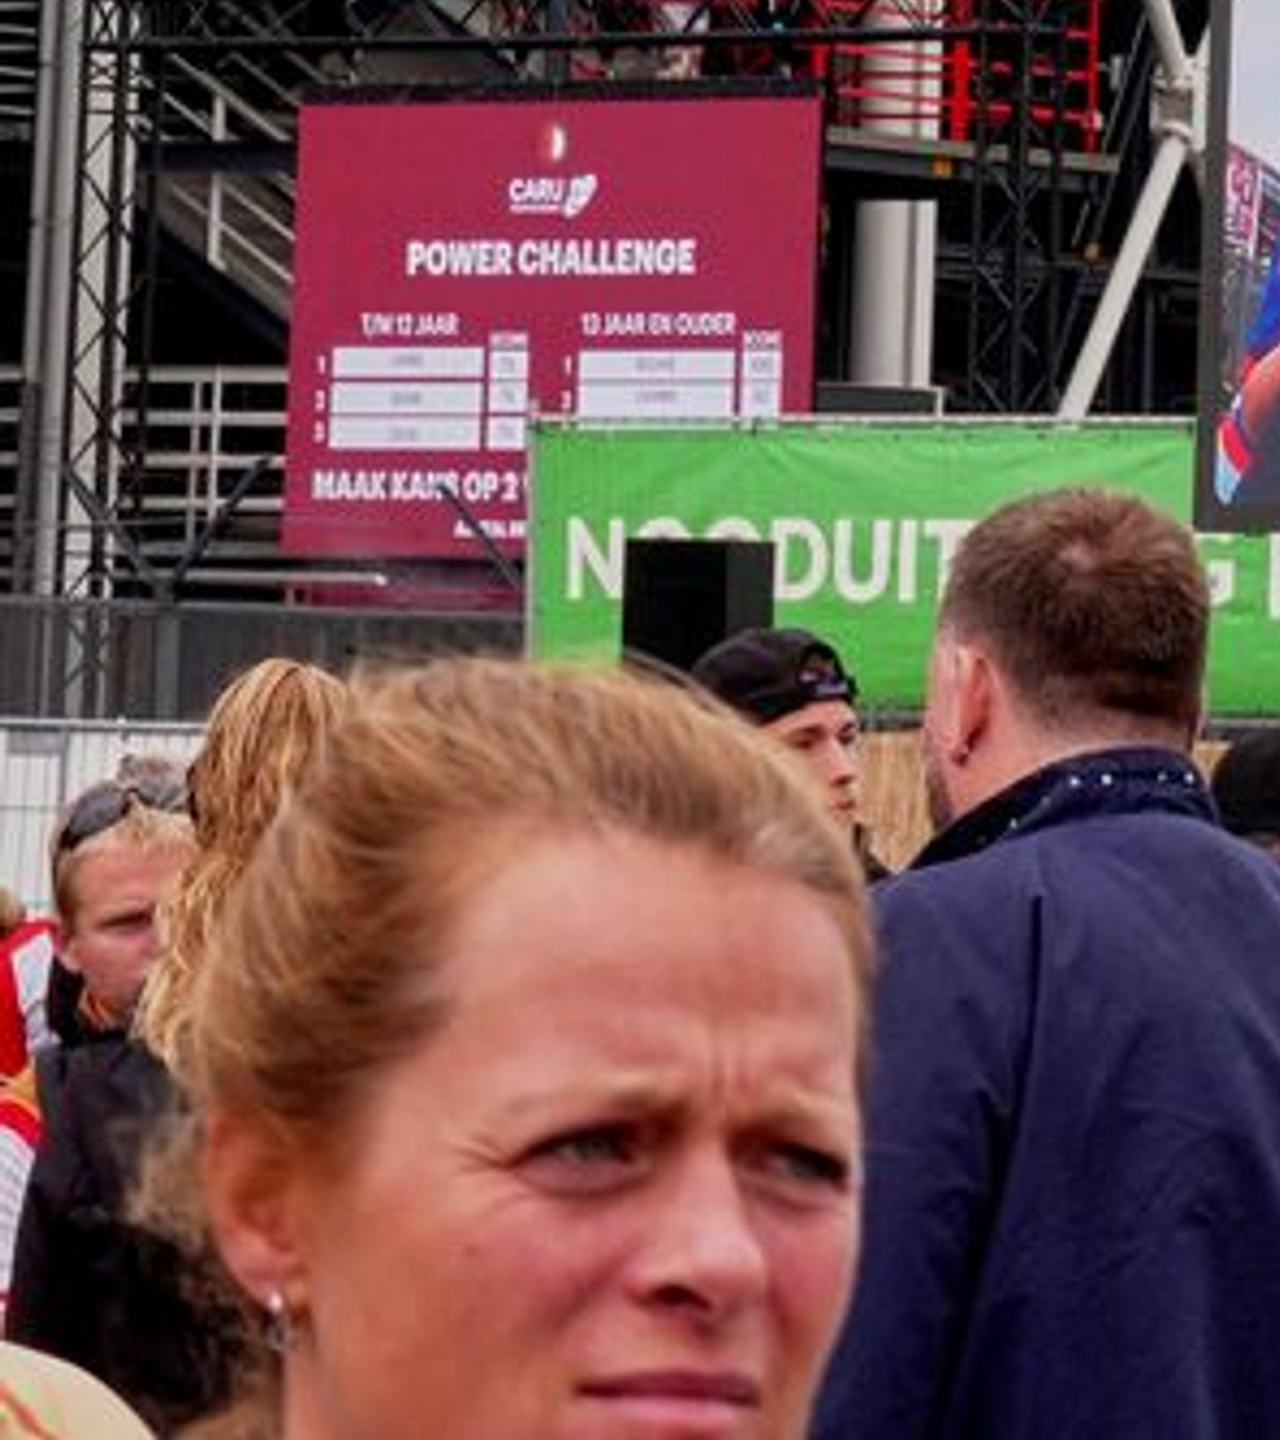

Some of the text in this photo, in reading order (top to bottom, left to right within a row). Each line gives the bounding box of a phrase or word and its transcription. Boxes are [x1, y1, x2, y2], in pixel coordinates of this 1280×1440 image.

[406, 238, 697, 277] POWER CHALLENGE
[415, 312, 459, 335] JAAR
[603, 312, 645, 336] JAAR
[311, 468, 386, 501] MAAK
[462, 470, 499, 502] OP
